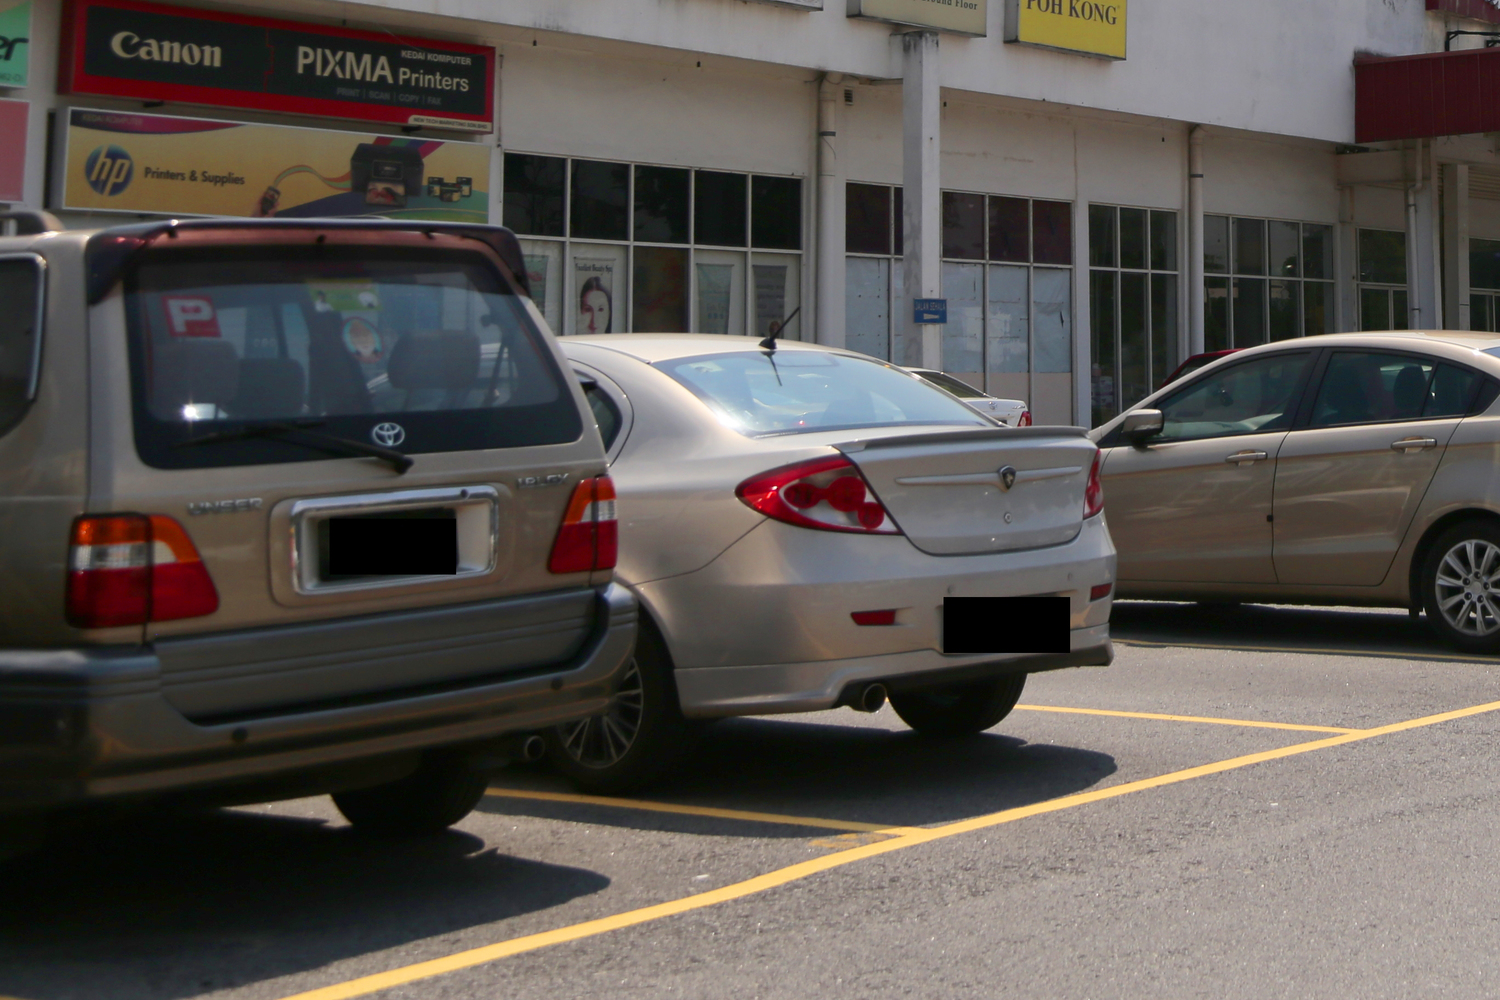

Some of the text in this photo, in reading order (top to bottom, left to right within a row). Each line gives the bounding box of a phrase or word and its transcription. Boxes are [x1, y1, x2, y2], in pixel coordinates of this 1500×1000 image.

[111, 30, 222, 68] Canon
[401, 50, 472, 66] KEDAI KOMPUTER
[297, 45, 394, 84] PIXMA
[398, 67, 470, 92] Printers
[336, 87, 442, 105] PRINT SCAN COPY FAX
[90, 146, 131, 195] hp
[144, 166, 245, 186] Printers & Supplies
[167, 298, 213, 332] P
